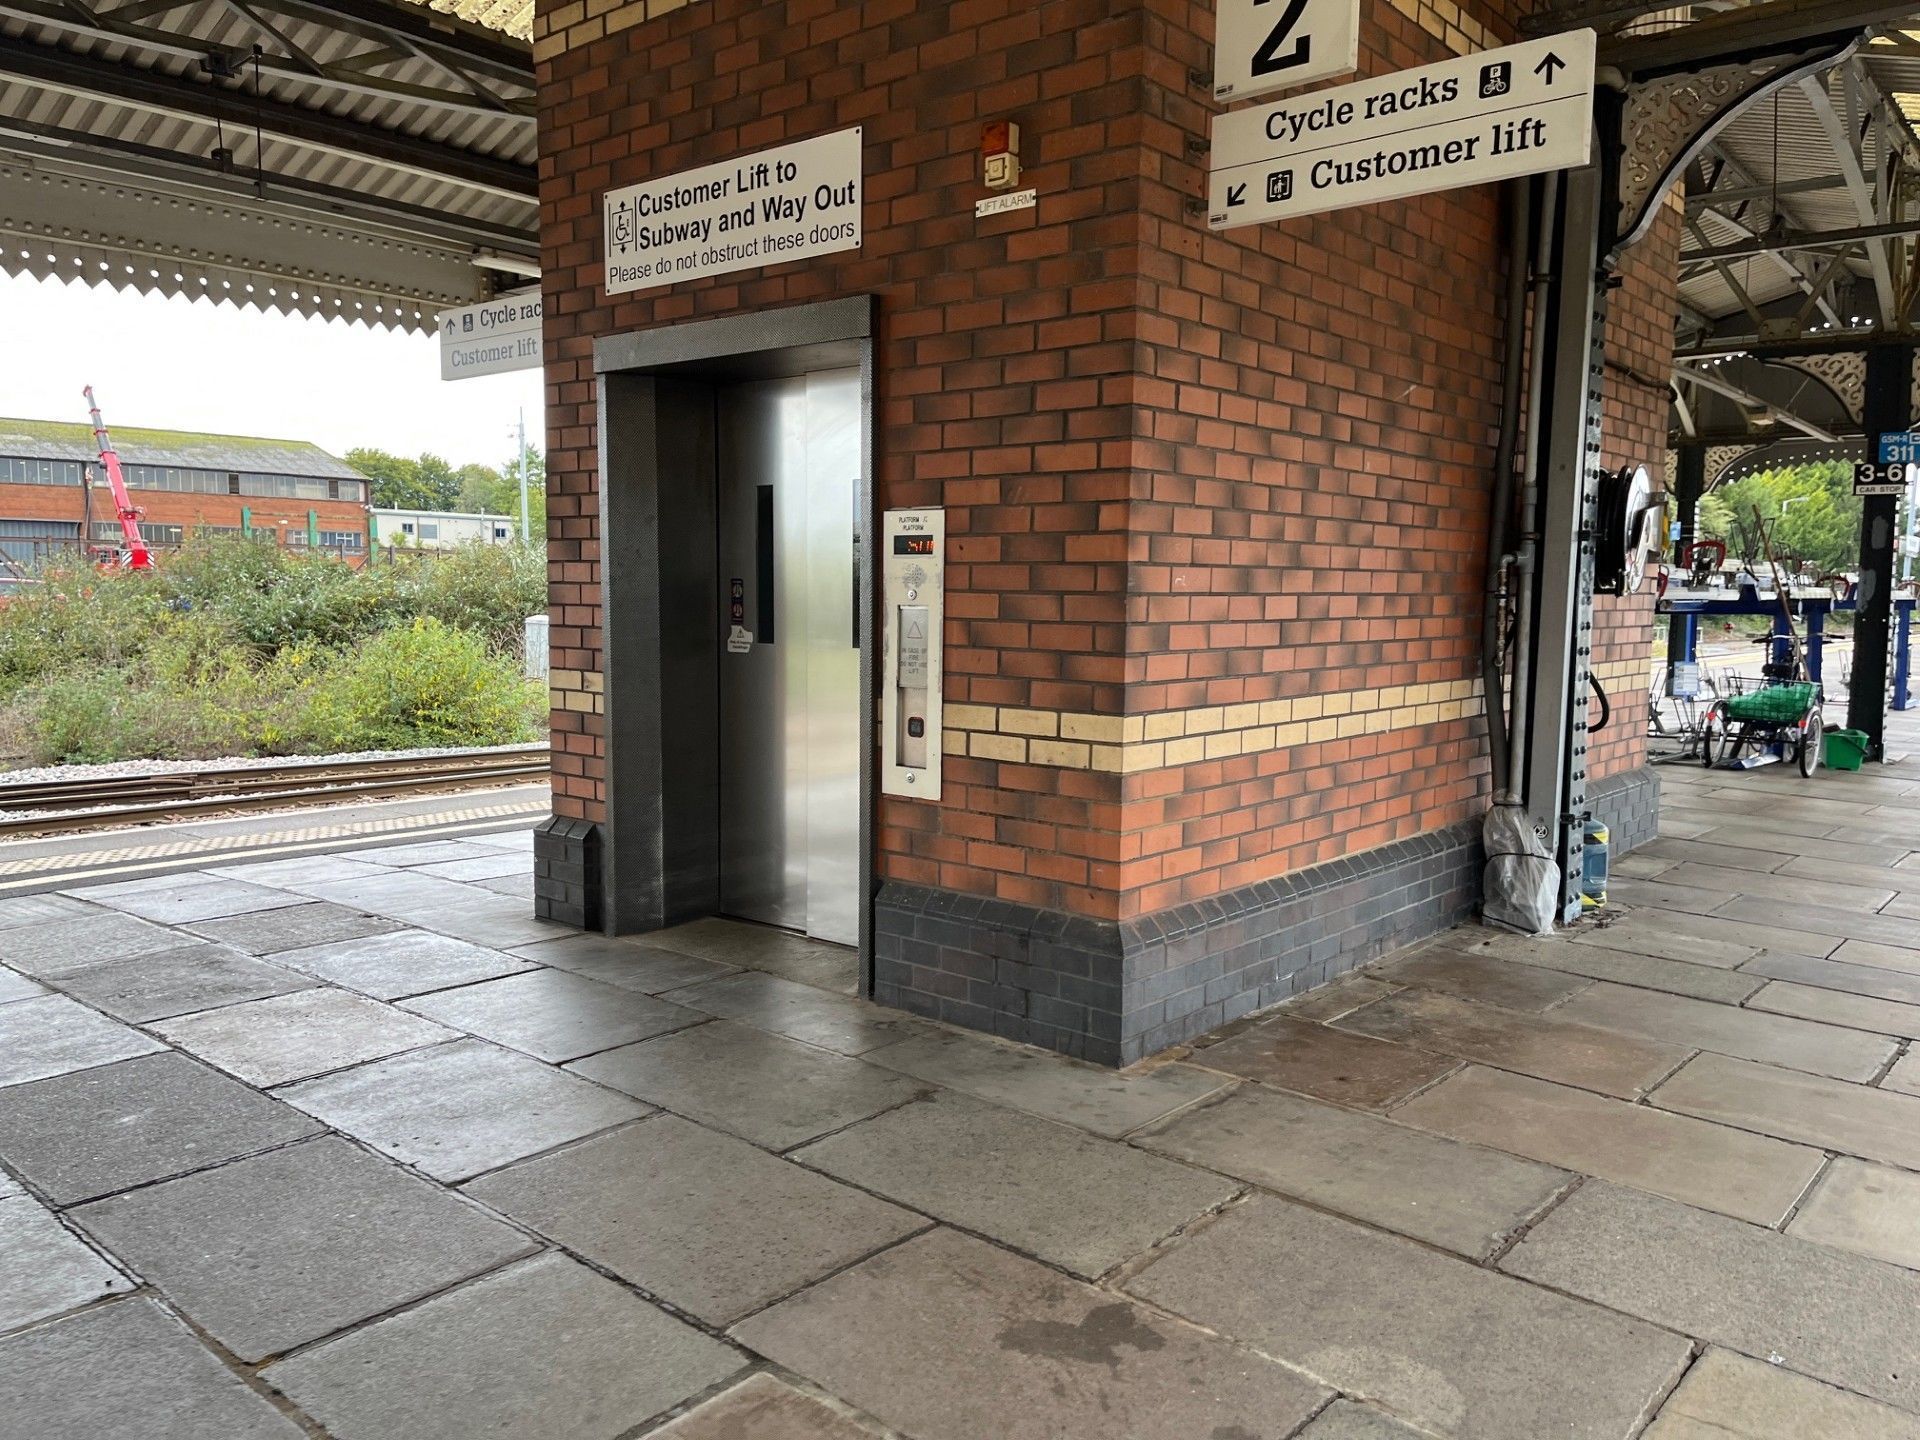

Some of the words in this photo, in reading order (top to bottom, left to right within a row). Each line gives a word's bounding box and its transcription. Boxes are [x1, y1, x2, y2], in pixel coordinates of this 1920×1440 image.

[1265, 100, 1354, 143] Cycle
[1364, 77, 1459, 120] racks
[1310, 135, 1481, 190] Customer
[1490, 117, 1547, 155] lift
[638, 178, 731, 217] Customer
[737, 163, 769, 194] Lift
[776, 161, 797, 184] to
[979, 200, 998, 213] LIFT
[999, 193, 1033, 208] ALARM
[639, 217, 712, 250] Subway
[718, 202, 755, 233] and
[762, 192, 807, 224] Way
[814, 180, 856, 211] Out
[609, 262, 652, 285] Please
[655, 257, 672, 276] do
[676, 252, 697, 271] not
[701, 239, 759, 267] obstruct
[763, 228, 804, 254] these
[810, 219, 855, 245] doors
[480, 305, 516, 329] Cycle
[520, 302, 541, 320] rac
[451, 344, 514, 367] Customer
[517, 337, 538, 357] lift
[1859, 463, 1903, 482] 3-6
[1887, 445, 1915, 461] 311
